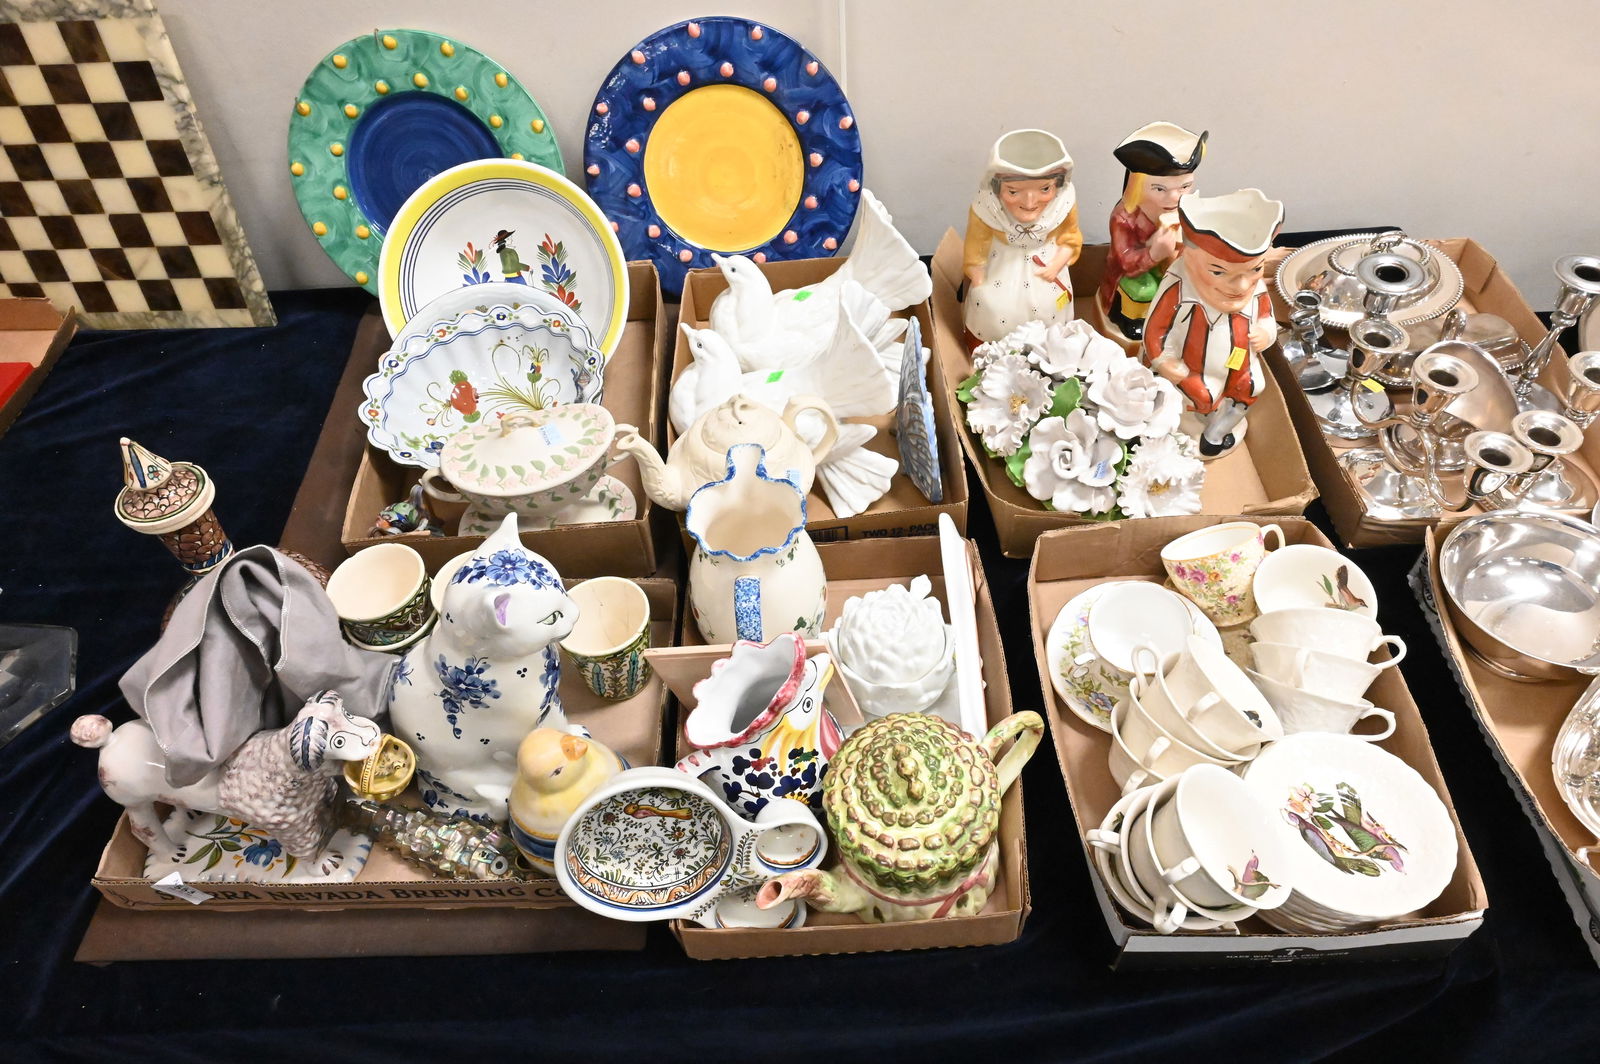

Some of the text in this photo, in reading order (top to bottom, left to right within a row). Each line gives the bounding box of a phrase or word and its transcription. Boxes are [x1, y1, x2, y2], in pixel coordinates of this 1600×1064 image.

[862, 529, 887, 538] TWO
[155, 889, 262, 900] SRRA
[266, 890, 384, 900] NEVADA
[389, 887, 525, 898] BREWING
